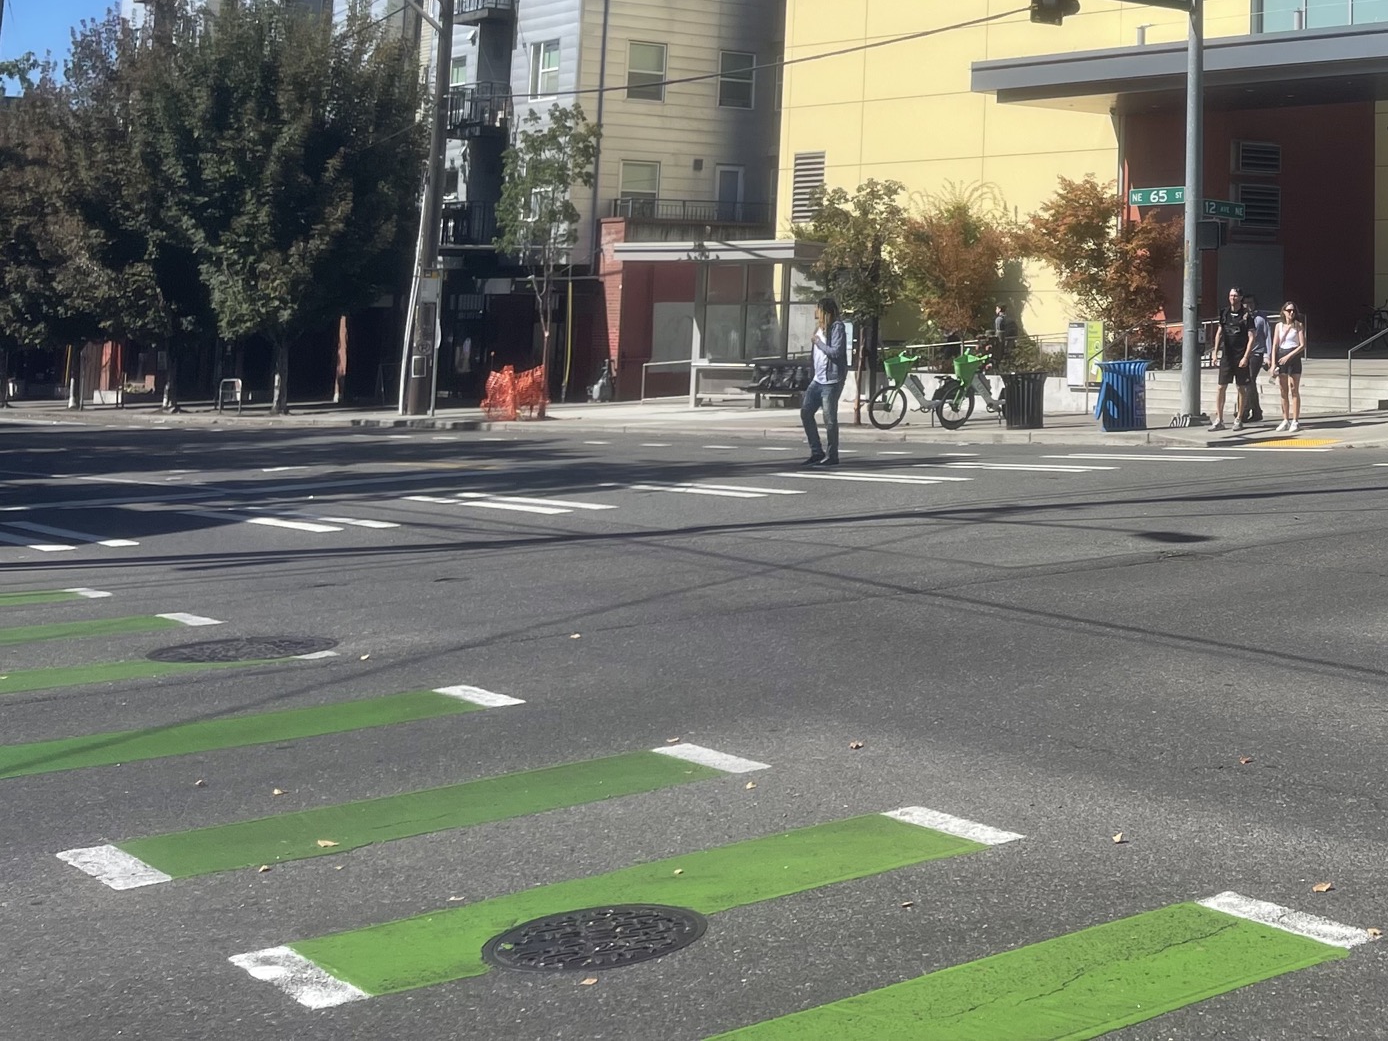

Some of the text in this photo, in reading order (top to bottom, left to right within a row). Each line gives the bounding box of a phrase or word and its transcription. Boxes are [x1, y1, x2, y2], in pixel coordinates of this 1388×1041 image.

[1132, 190, 1183, 203] NE 65 ST
[1204, 201, 1217, 214] 12
[1234, 207, 1244, 216] NE
